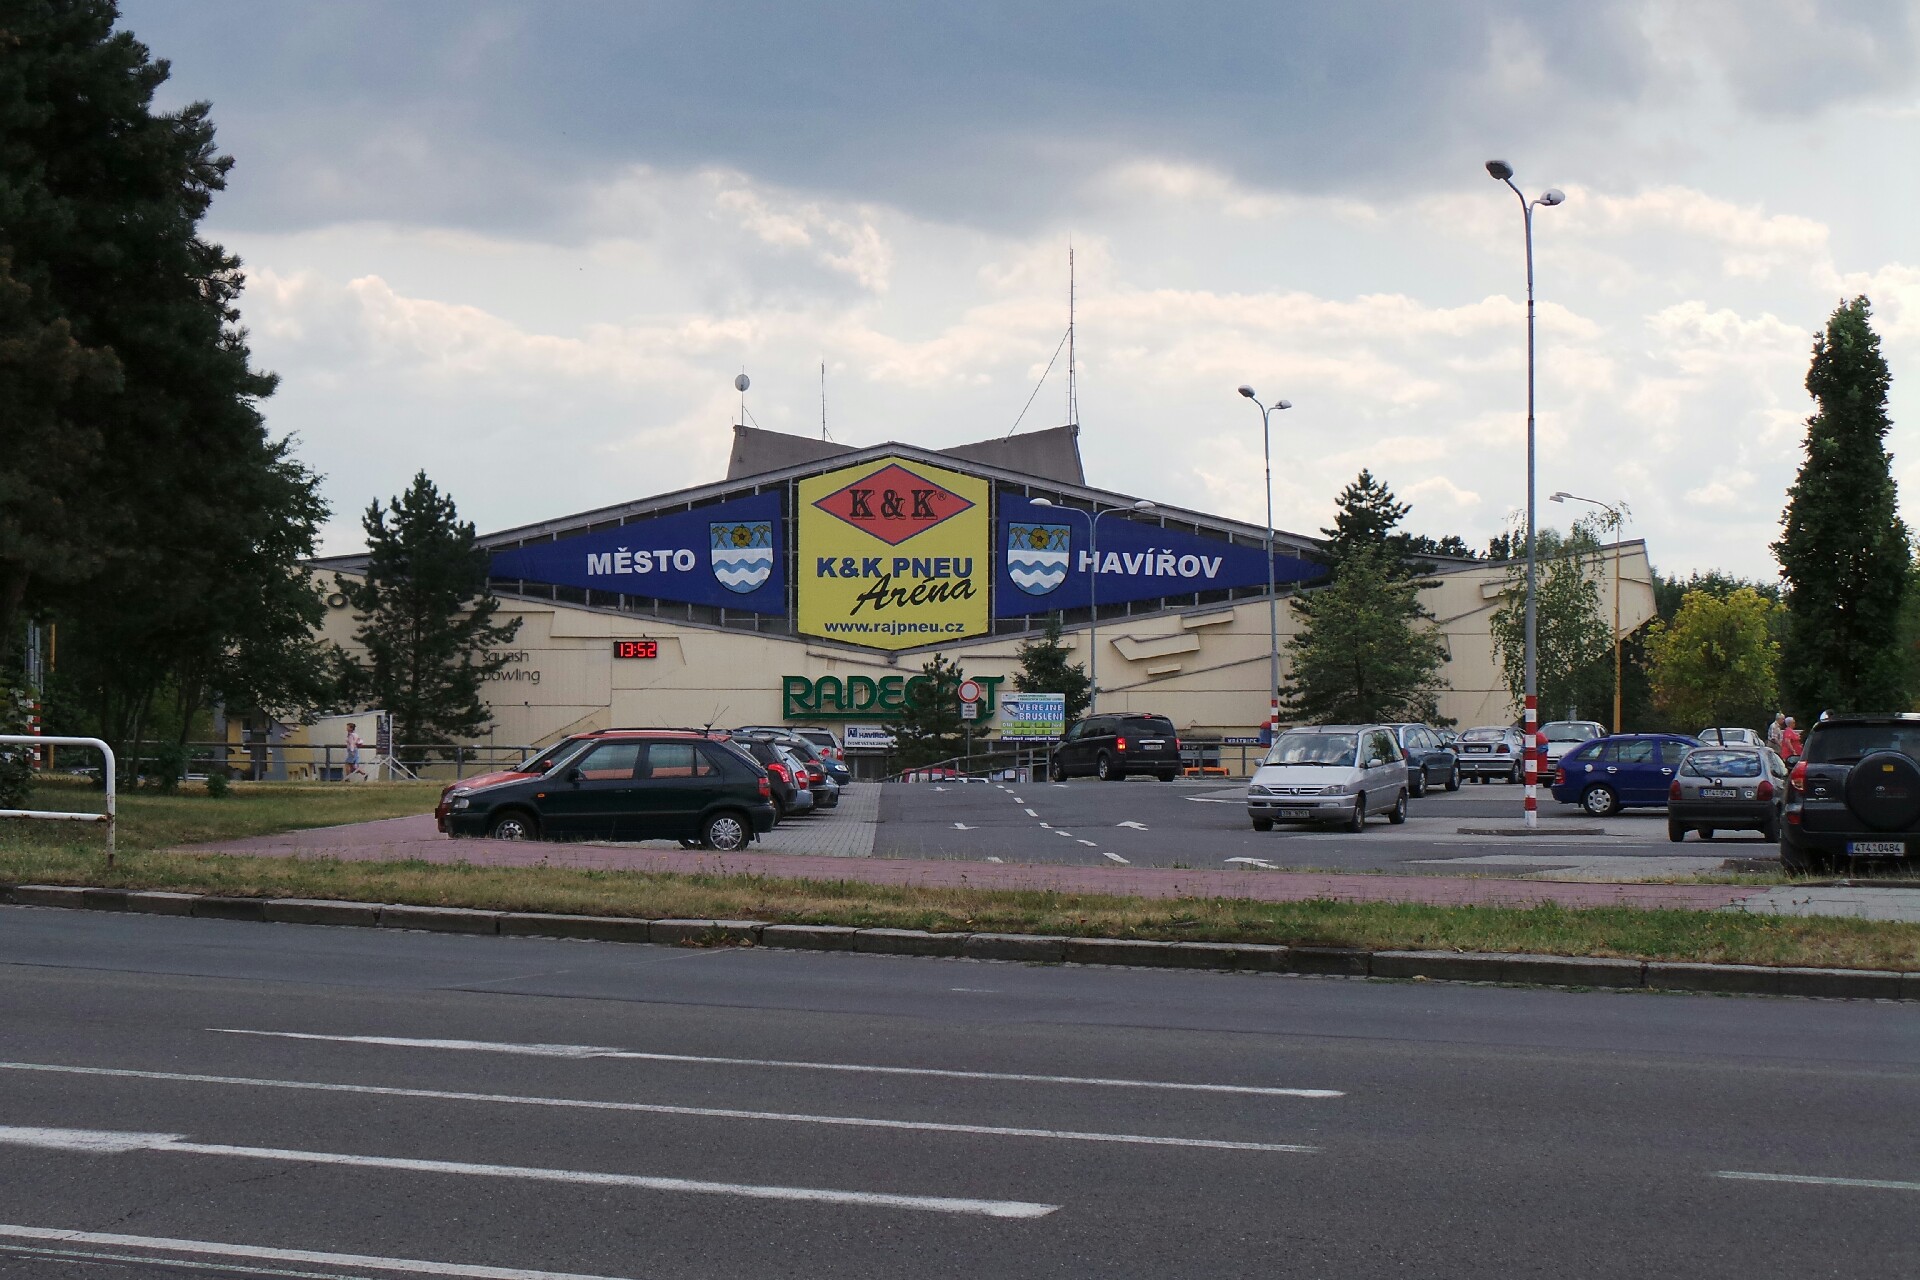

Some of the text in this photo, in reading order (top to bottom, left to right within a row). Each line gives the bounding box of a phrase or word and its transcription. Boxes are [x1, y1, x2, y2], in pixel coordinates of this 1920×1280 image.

[587, 546, 696, 576] MĚSTO
[816, 557, 974, 579] K&K PNEU
[1078, 547, 1223, 579] HAVÍŘOV
[850, 572, 977, 617] Aréna
[824, 620, 965, 636] www.rajpneu.cz
[482, 650, 530, 664] squash
[620, 642, 656, 657] 13:52
[1854, 843, 1901, 853] 4T4 0484
